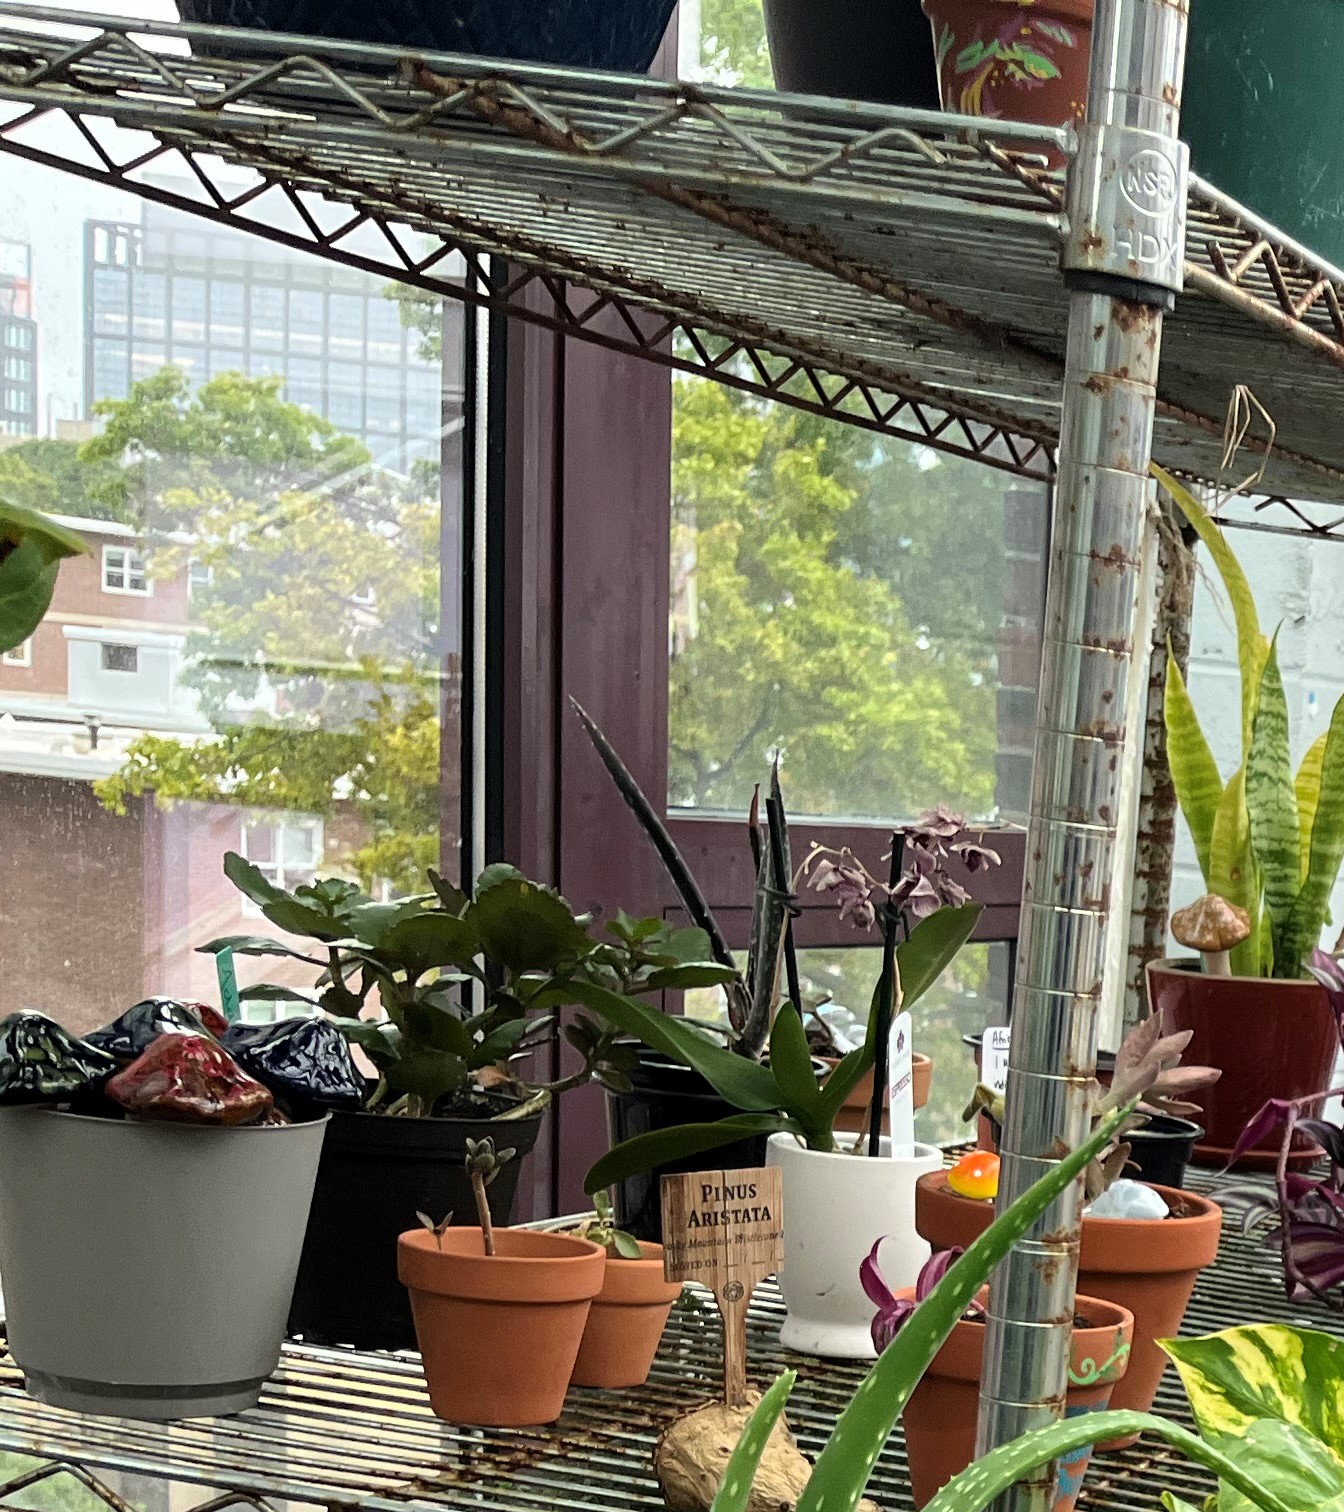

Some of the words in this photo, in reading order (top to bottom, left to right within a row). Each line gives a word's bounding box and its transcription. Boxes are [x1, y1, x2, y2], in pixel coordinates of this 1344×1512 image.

[1112, 225, 1178, 270] HDX
[701, 1184, 757, 1203] PINUS
[687, 1205, 772, 1228] ARISTATA
